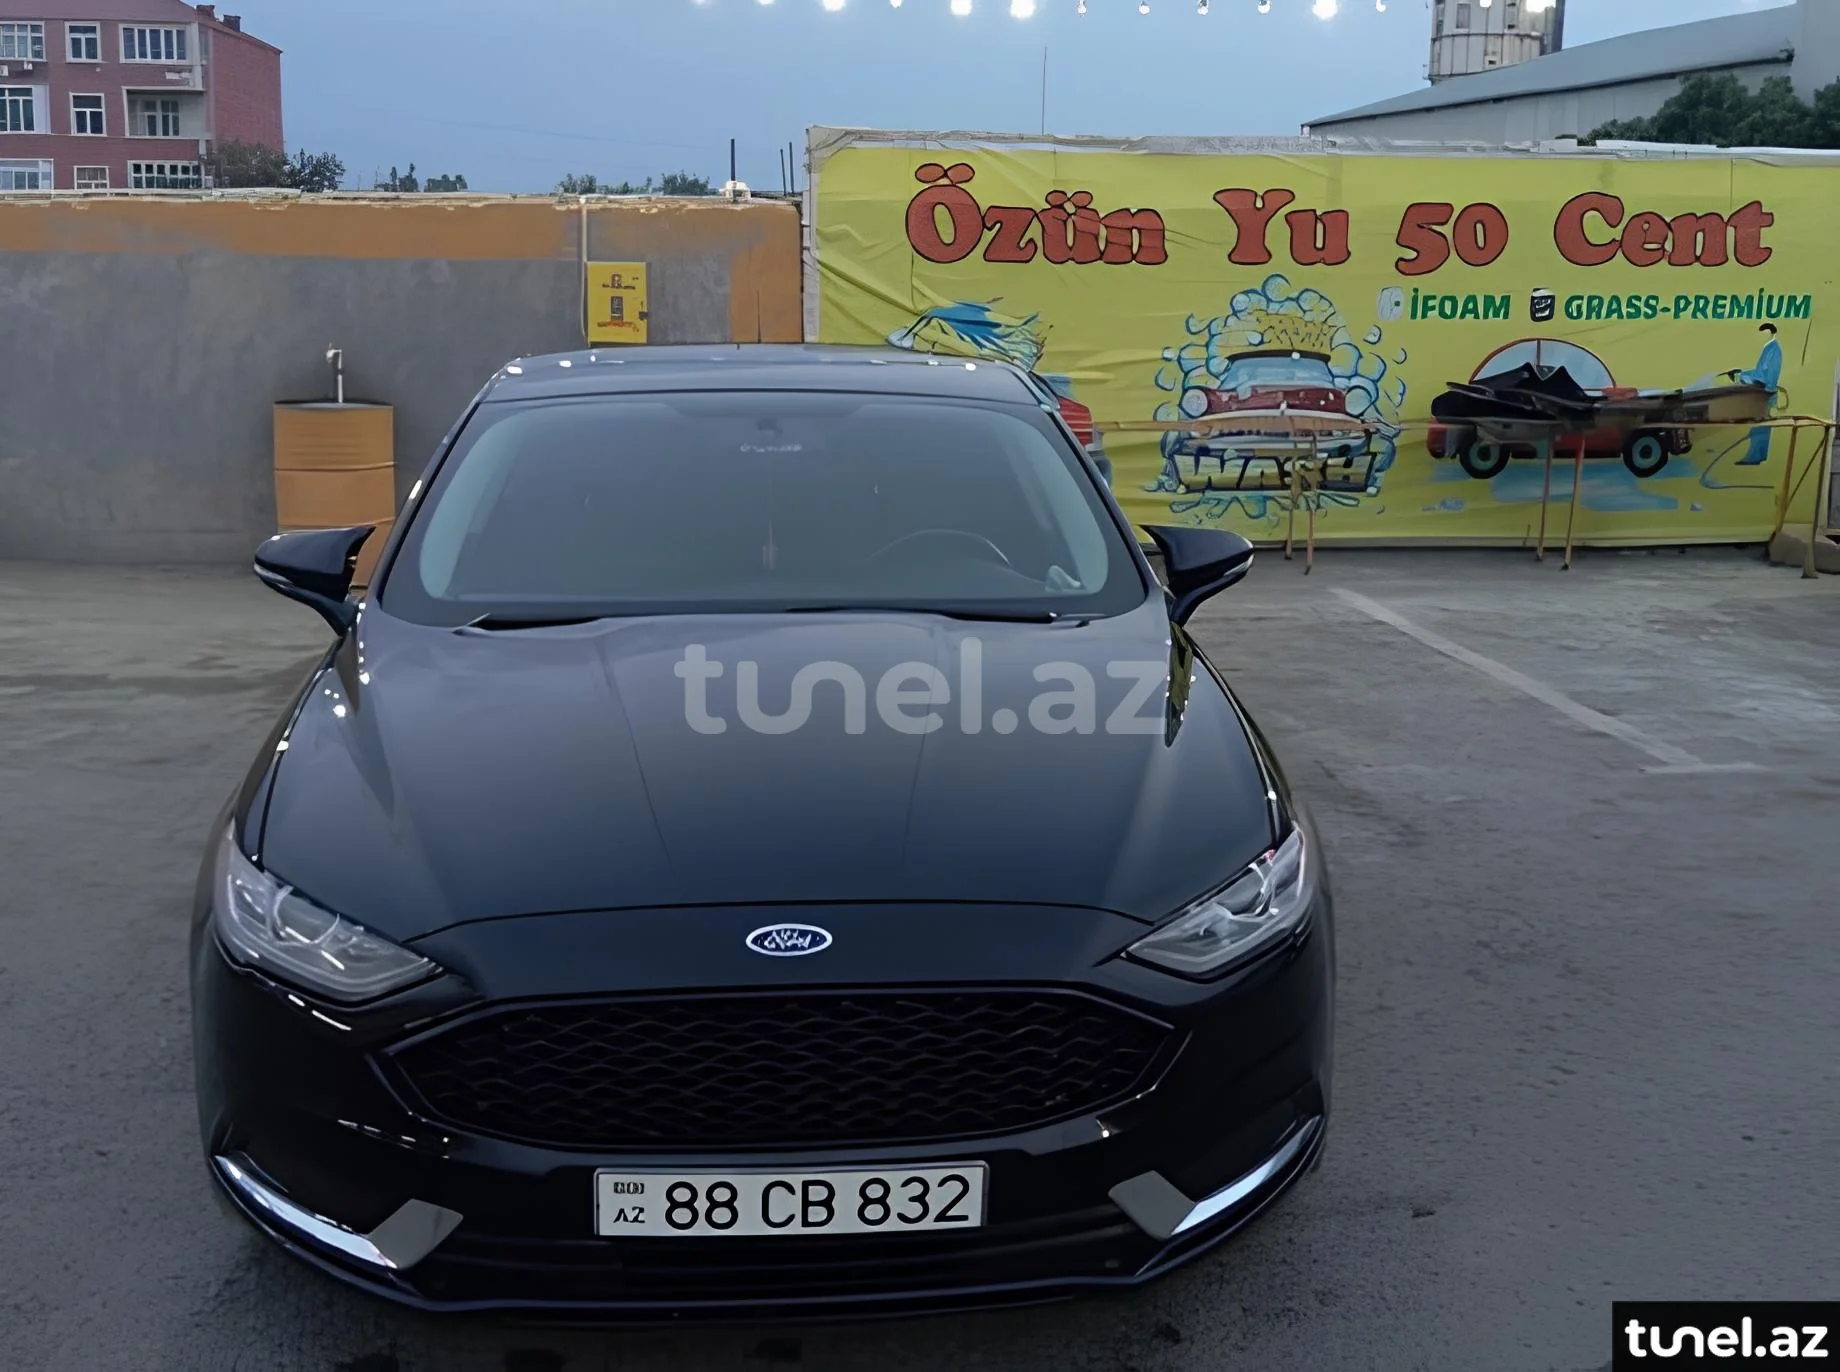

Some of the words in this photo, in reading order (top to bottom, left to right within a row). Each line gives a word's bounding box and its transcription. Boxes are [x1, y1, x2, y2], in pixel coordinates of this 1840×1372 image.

[905, 162, 1168, 265] Özün
[1213, 188, 1351, 266] Yu
[1395, 202, 1509, 276] 50
[1553, 191, 1774, 267] Cent
[613, 1206, 645, 1223] AZ
[664, 1180, 739, 1231] 88
[761, 1178, 836, 1229] CB
[857, 1173, 970, 1227] 832
